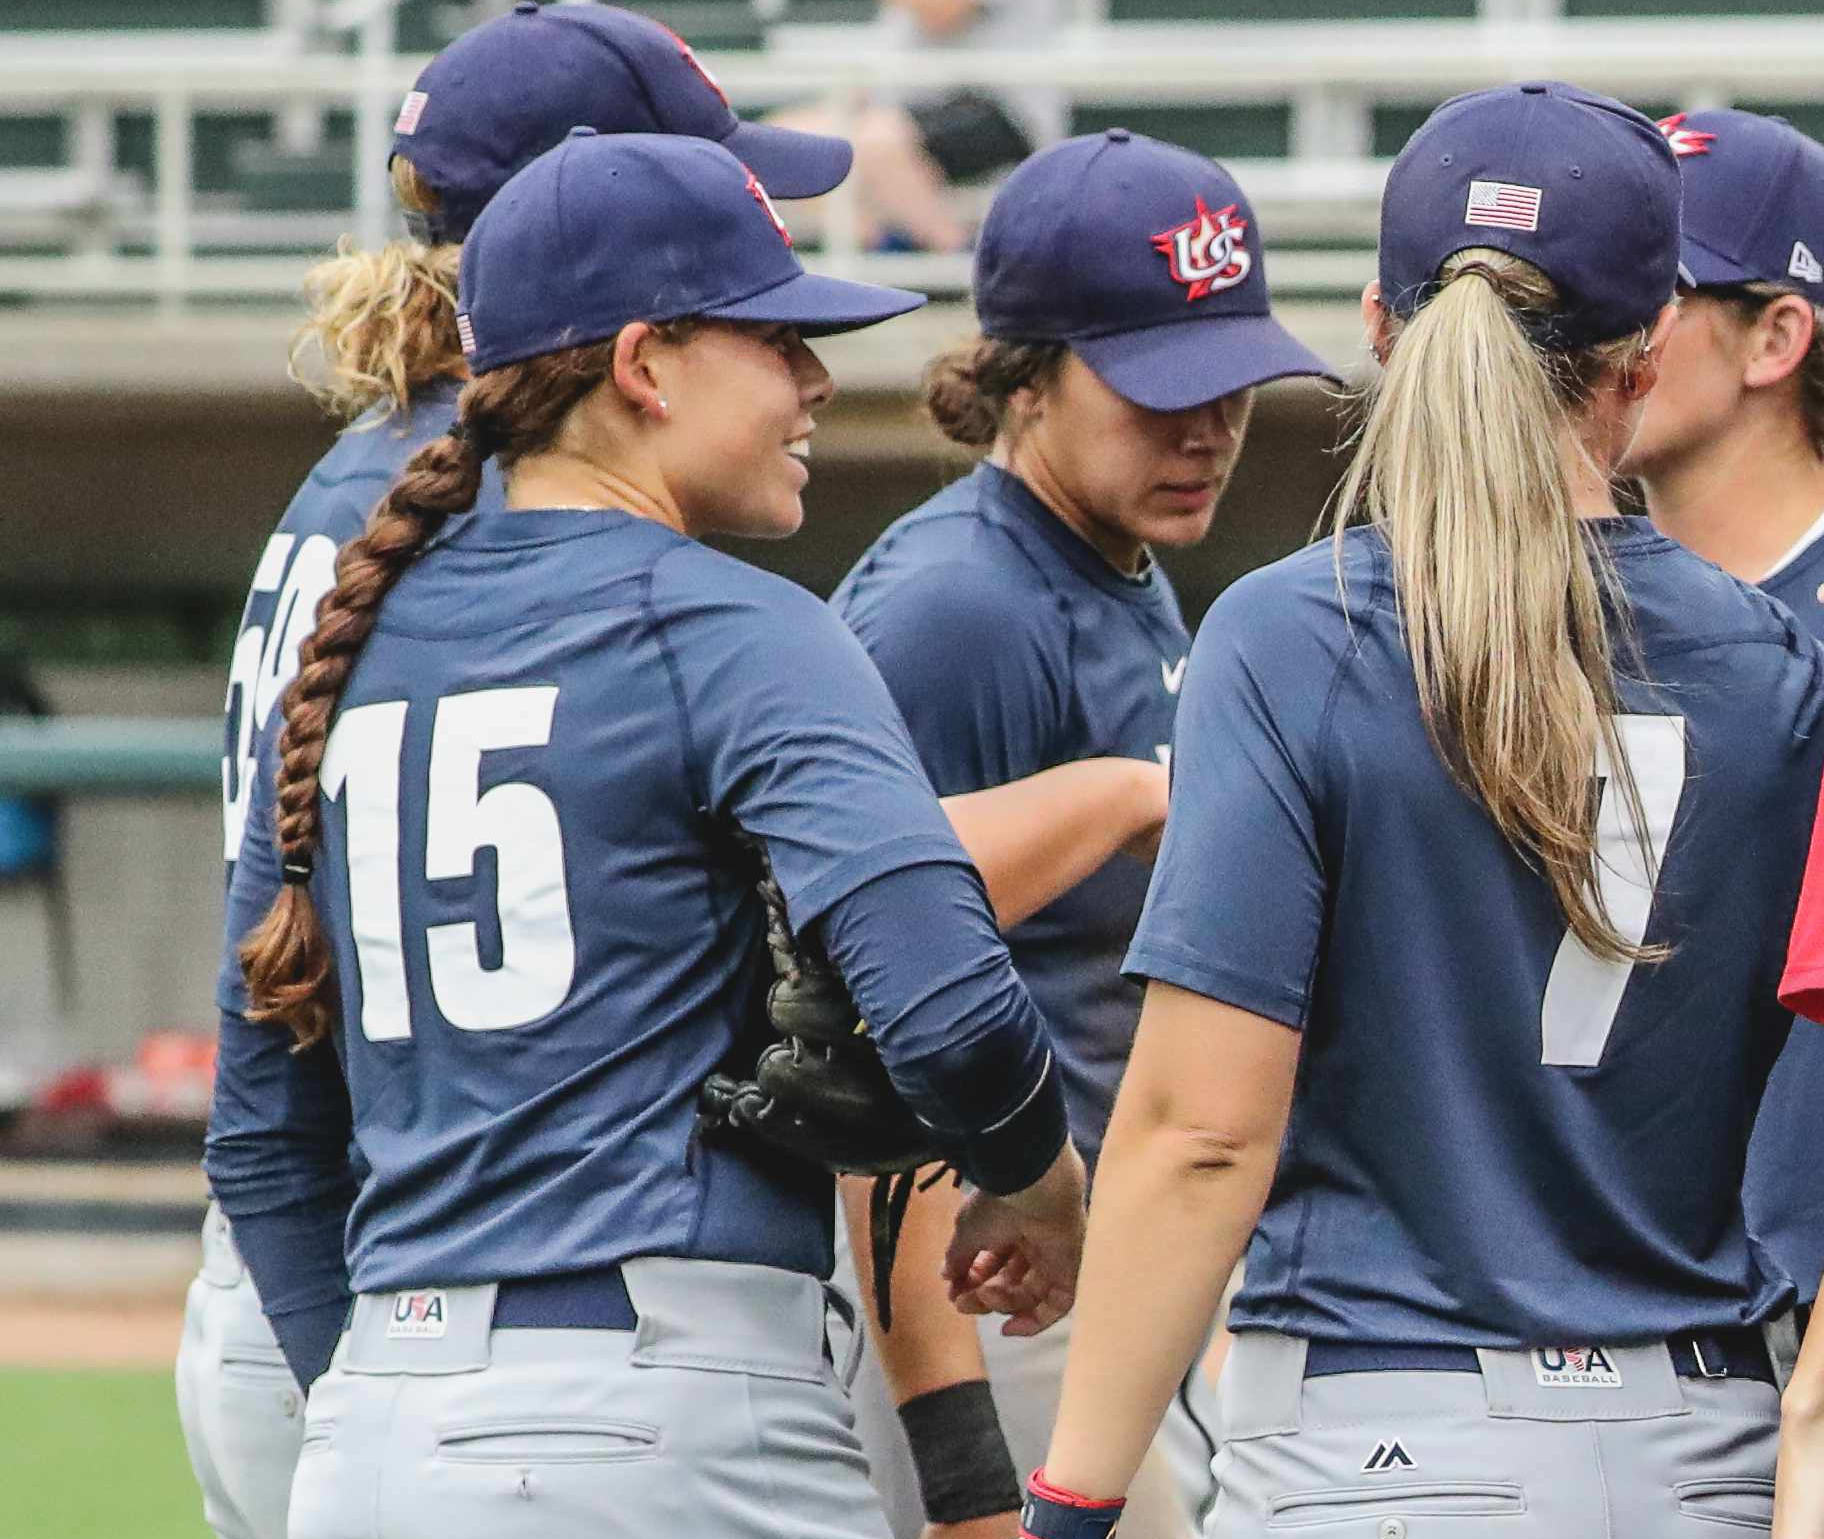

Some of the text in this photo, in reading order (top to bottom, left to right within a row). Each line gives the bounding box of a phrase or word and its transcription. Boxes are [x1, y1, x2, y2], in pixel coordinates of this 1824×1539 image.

[321, 686, 576, 1041] 15
[1541, 714, 1685, 1067] 7
[395, 1296, 442, 1322] USA
[1537, 1346, 1614, 1373] USA
